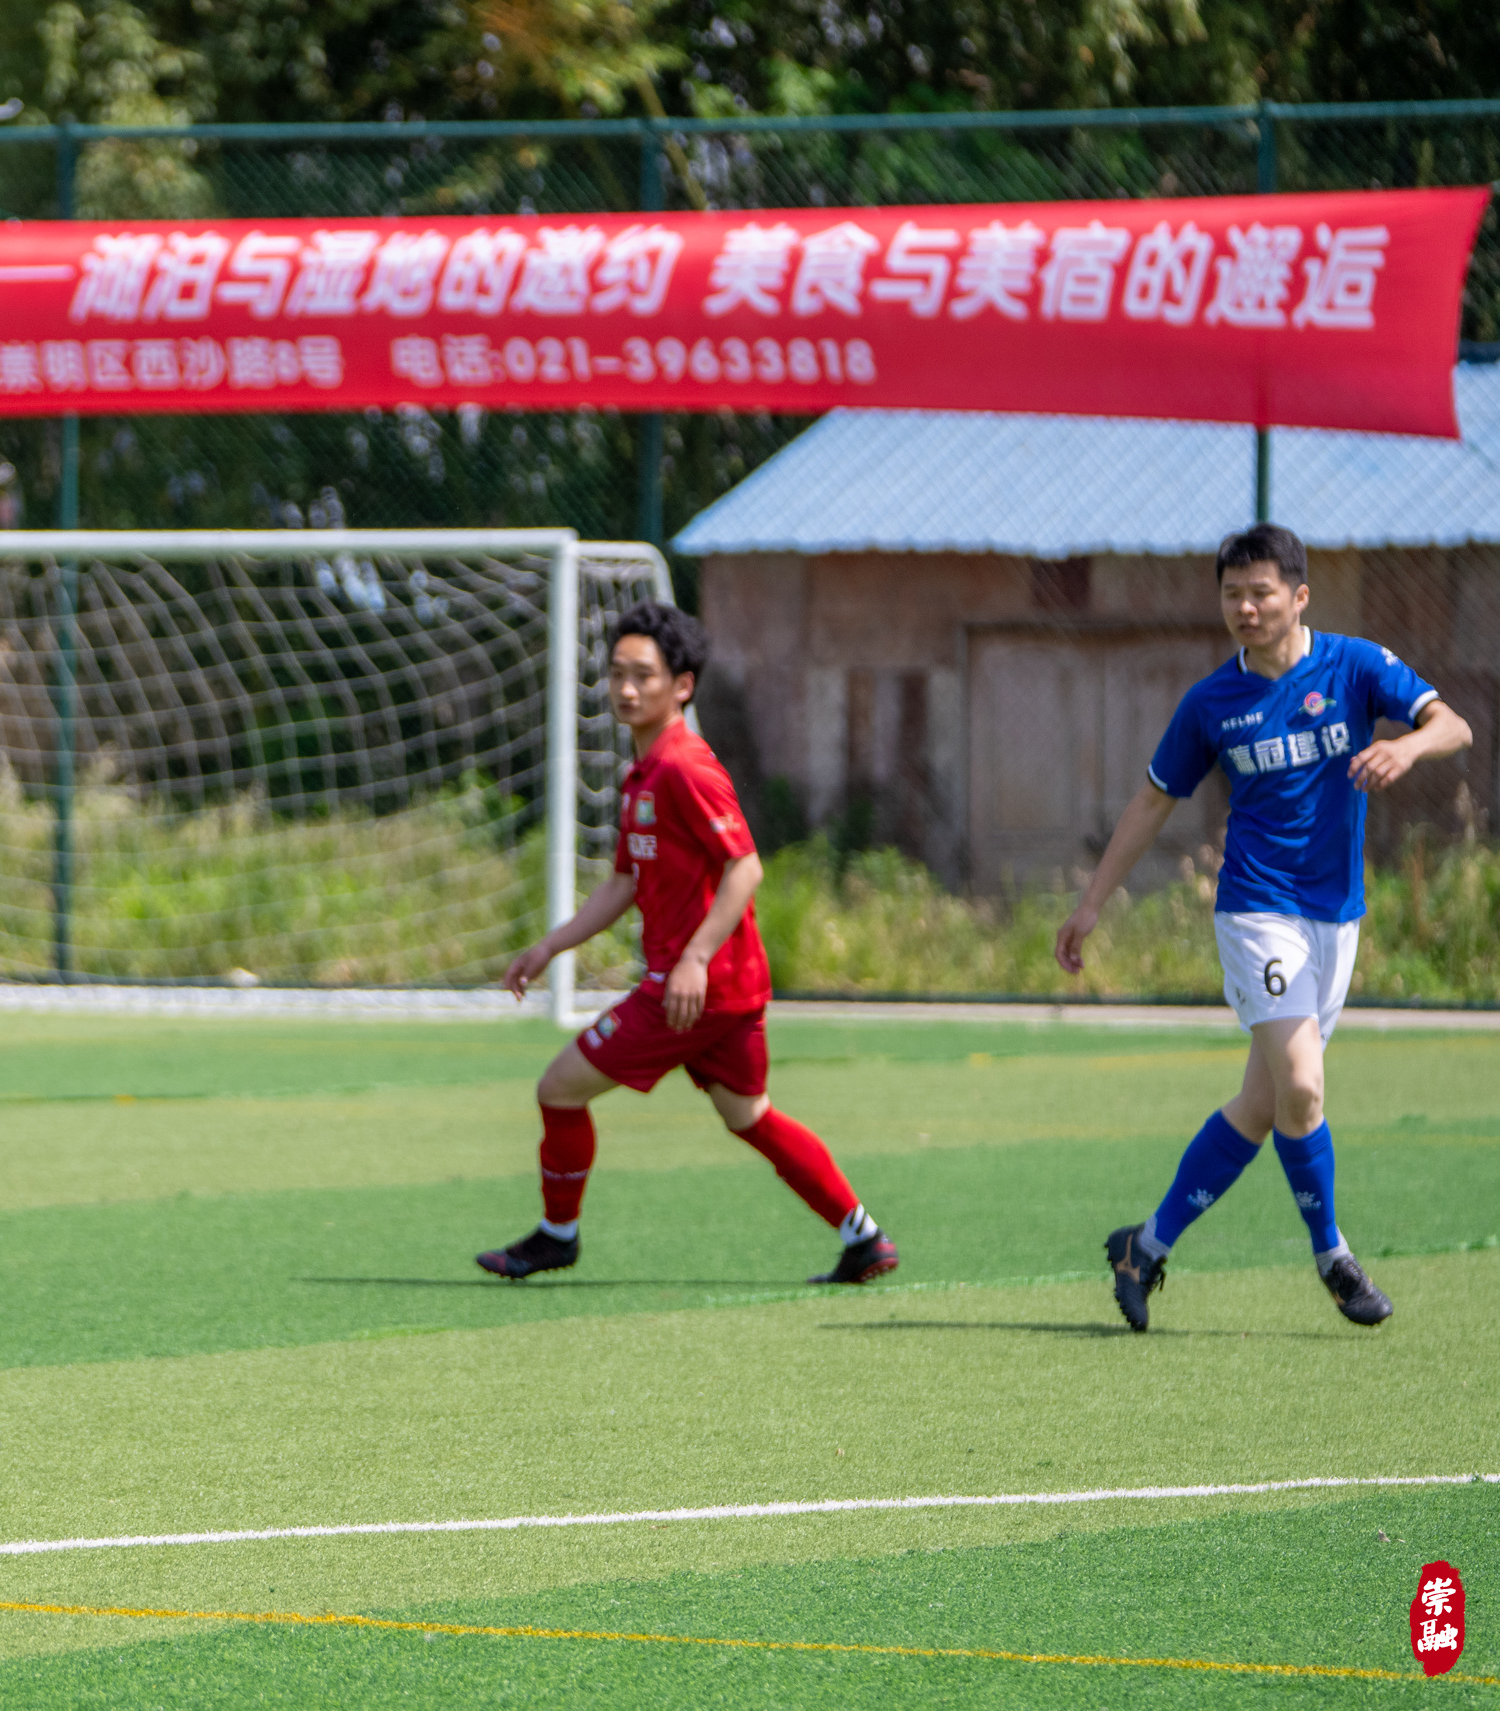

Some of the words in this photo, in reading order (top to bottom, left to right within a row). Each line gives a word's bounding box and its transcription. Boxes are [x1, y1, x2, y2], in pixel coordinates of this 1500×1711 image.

[703, 219, 1390, 331] 美食与美宿的邂逅
[1264, 957, 1288, 997] 6
